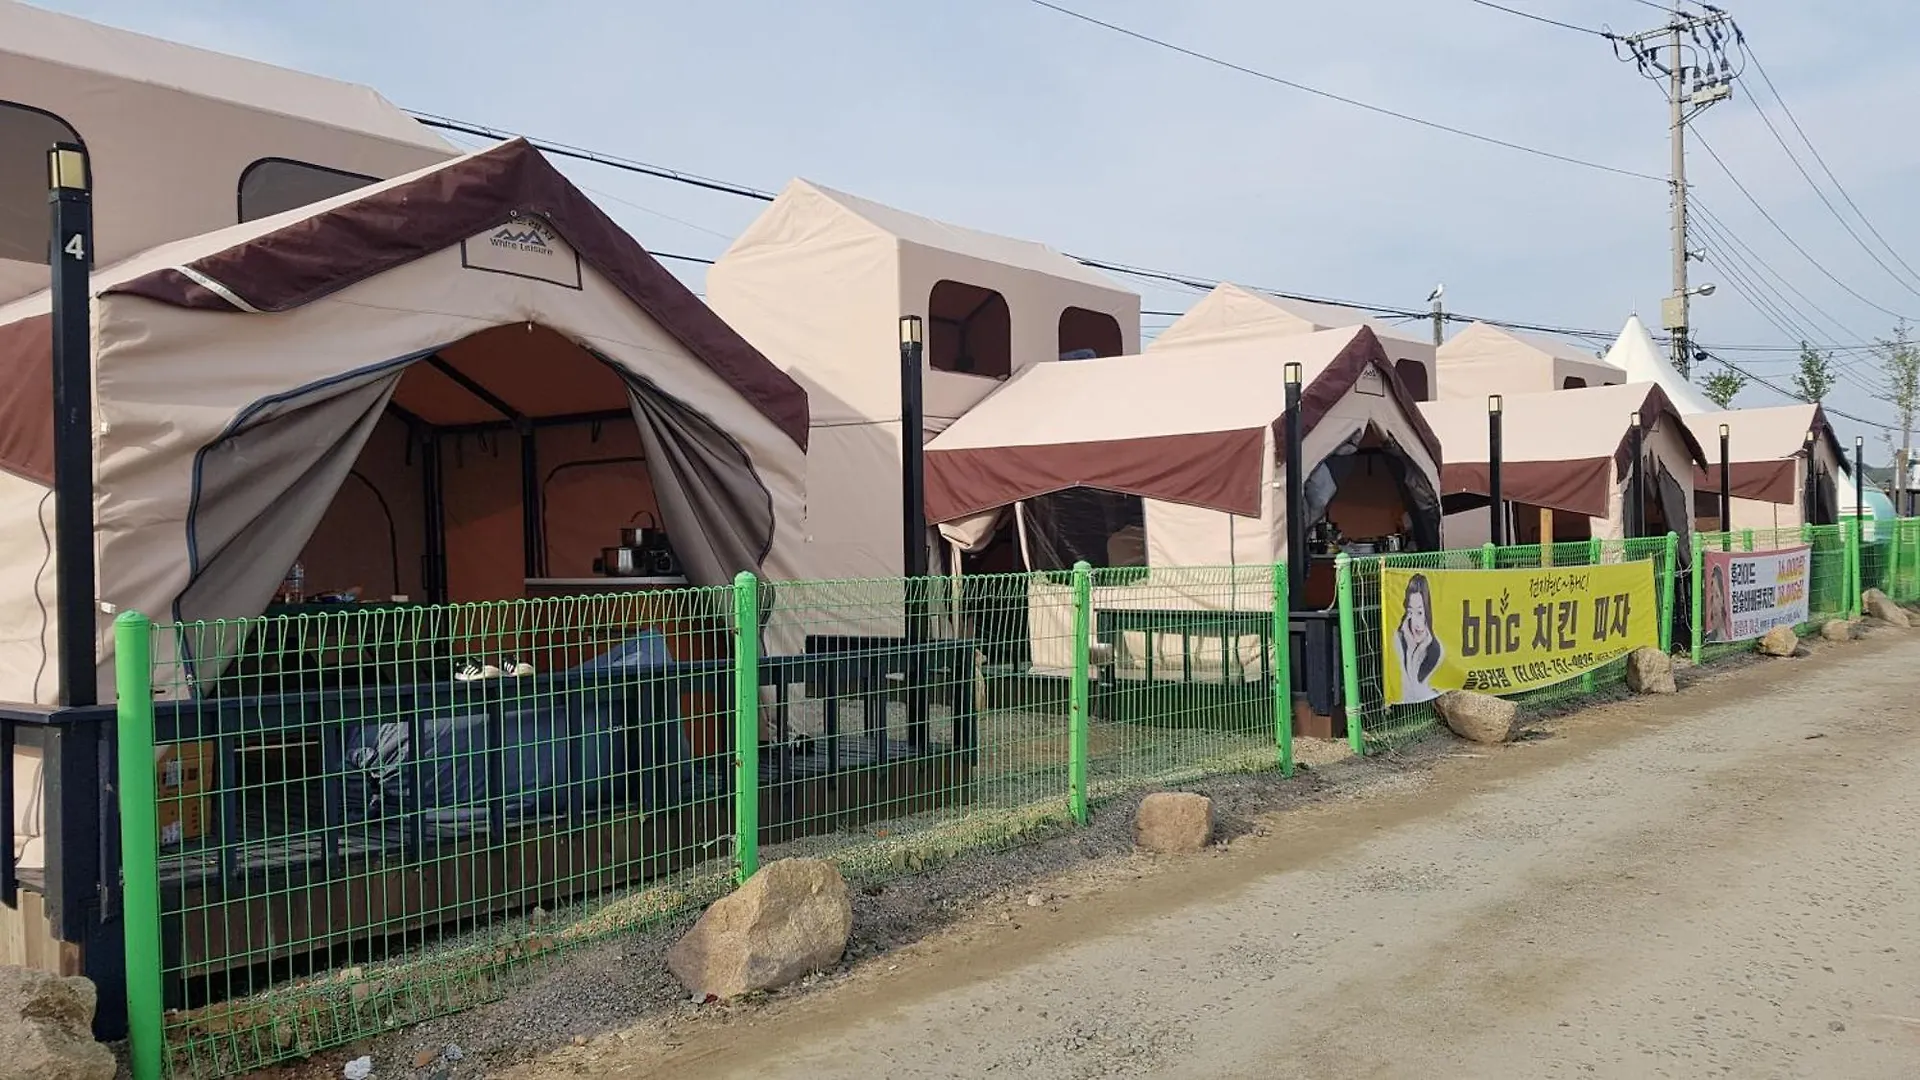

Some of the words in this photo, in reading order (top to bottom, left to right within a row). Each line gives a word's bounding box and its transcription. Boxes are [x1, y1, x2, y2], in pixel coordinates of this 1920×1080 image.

[65, 233, 84, 260] 4
[489, 237, 517, 250] White
[520, 241, 554, 256] Leisure
[1731, 563, 1756, 586] 후라이드
[1461, 598, 1520, 657] bhc
[1532, 600, 1578, 652] 치킨
[1592, 592, 1631, 642] 피자
